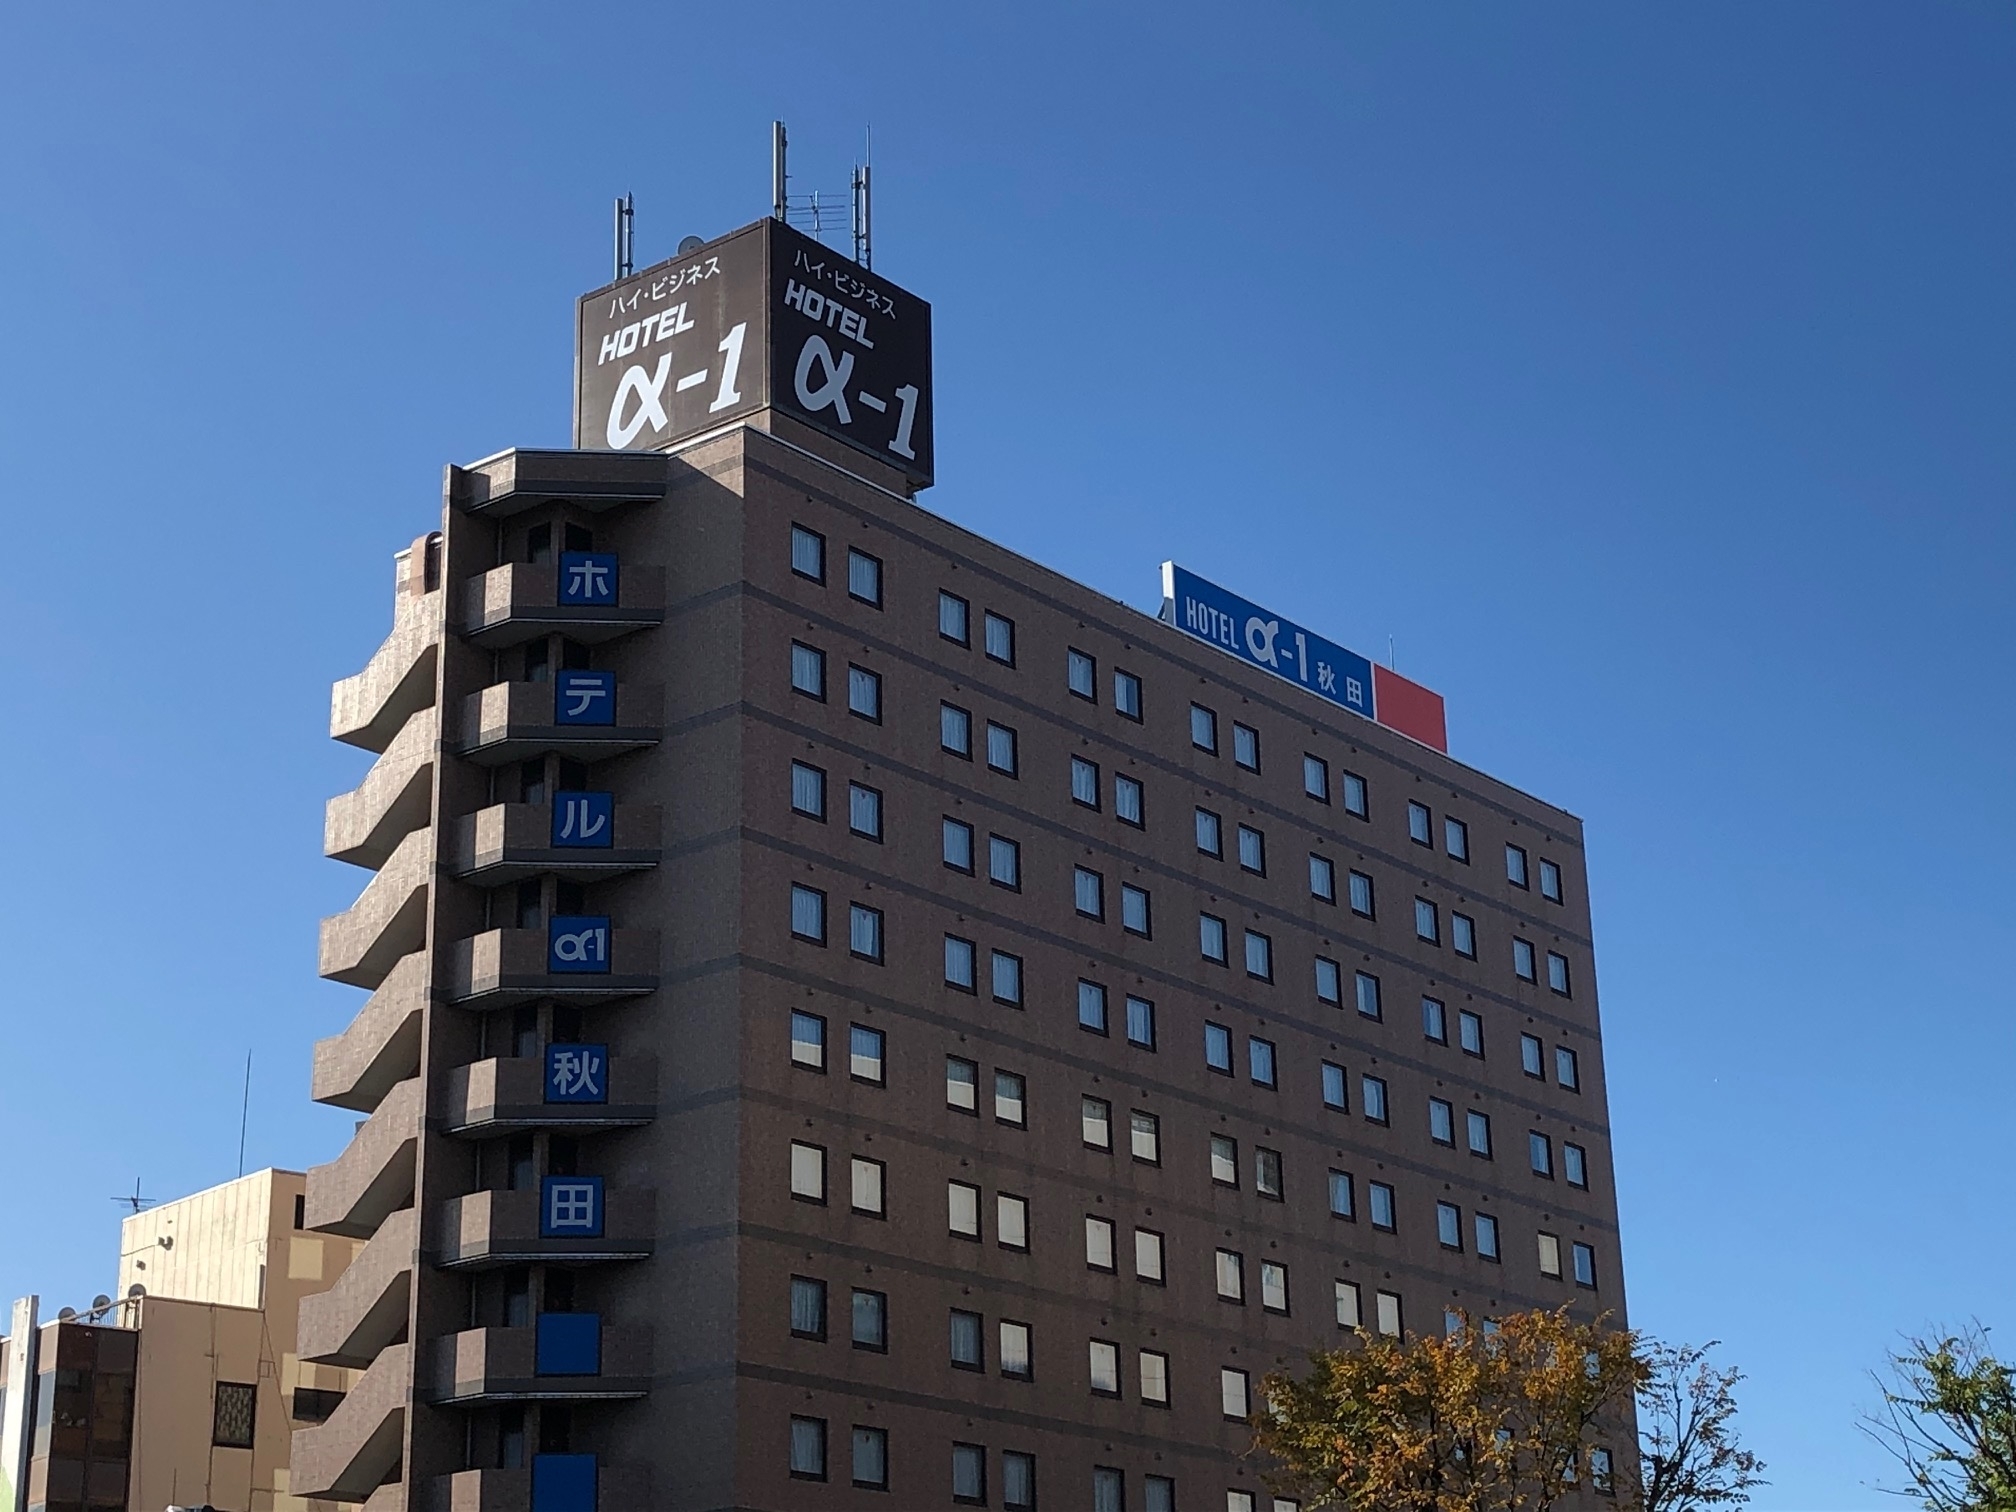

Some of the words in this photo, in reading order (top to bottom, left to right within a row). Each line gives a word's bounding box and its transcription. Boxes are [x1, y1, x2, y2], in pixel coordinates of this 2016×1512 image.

[597, 302, 695, 366] HOTEL
[784, 278, 874, 349] HOTEL
[1186, 596, 1239, 650] HOTEL
